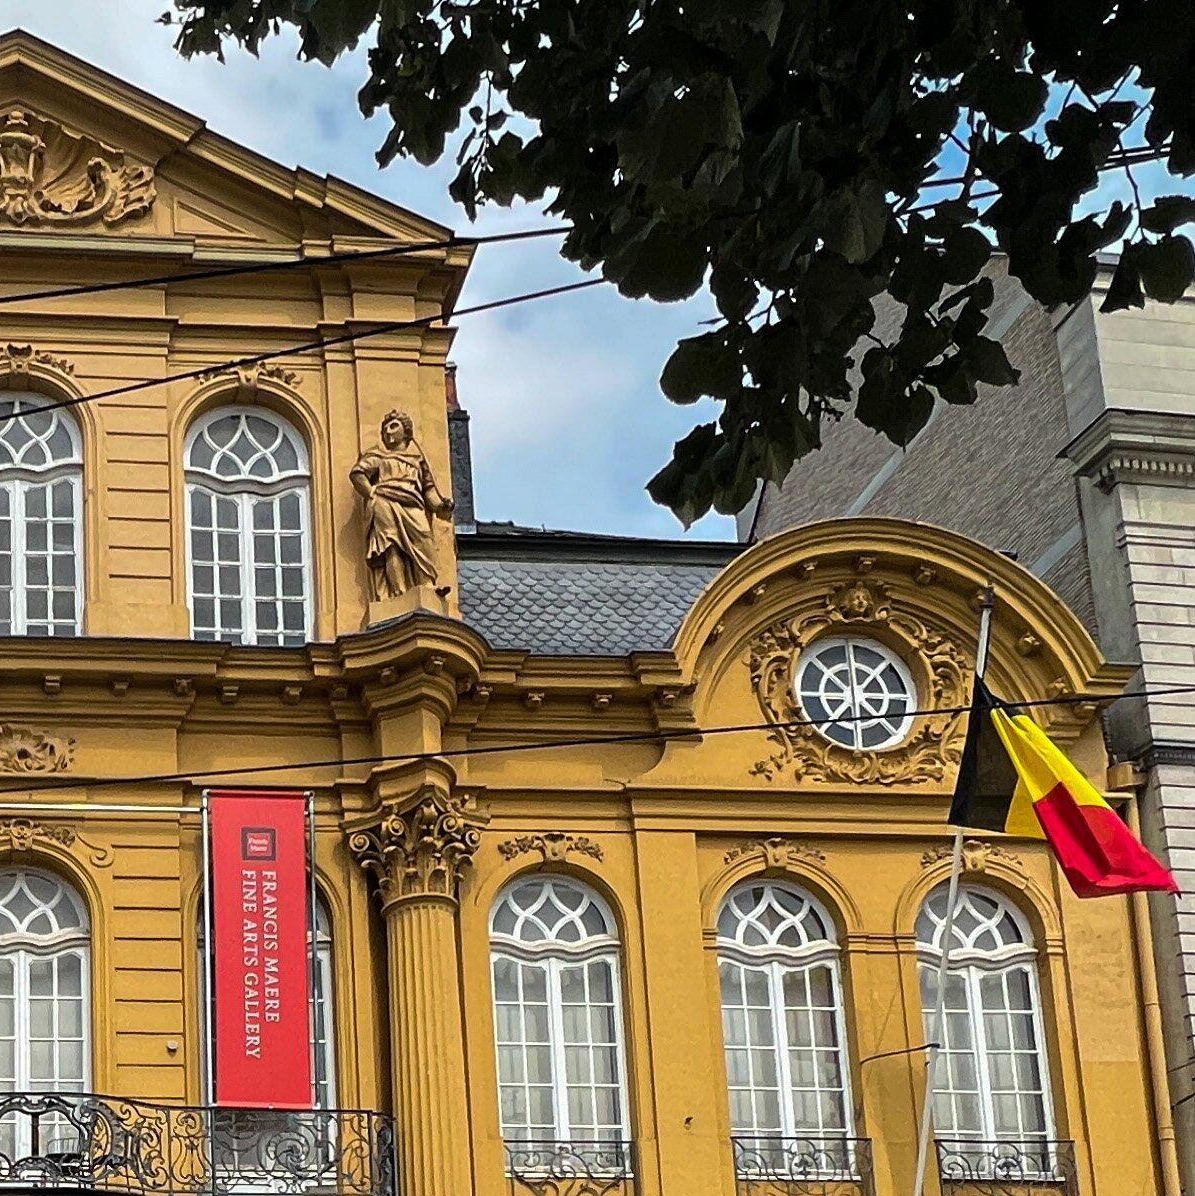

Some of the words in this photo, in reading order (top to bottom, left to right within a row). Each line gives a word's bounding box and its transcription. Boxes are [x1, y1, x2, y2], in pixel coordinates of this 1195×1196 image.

[241, 869, 258, 913] FINE
[261, 870, 279, 951] FRANCIS
[243, 918, 259, 967] ARTS
[244, 972, 261, 1059] GALLERY
[264, 956, 280, 1022] MAERE
